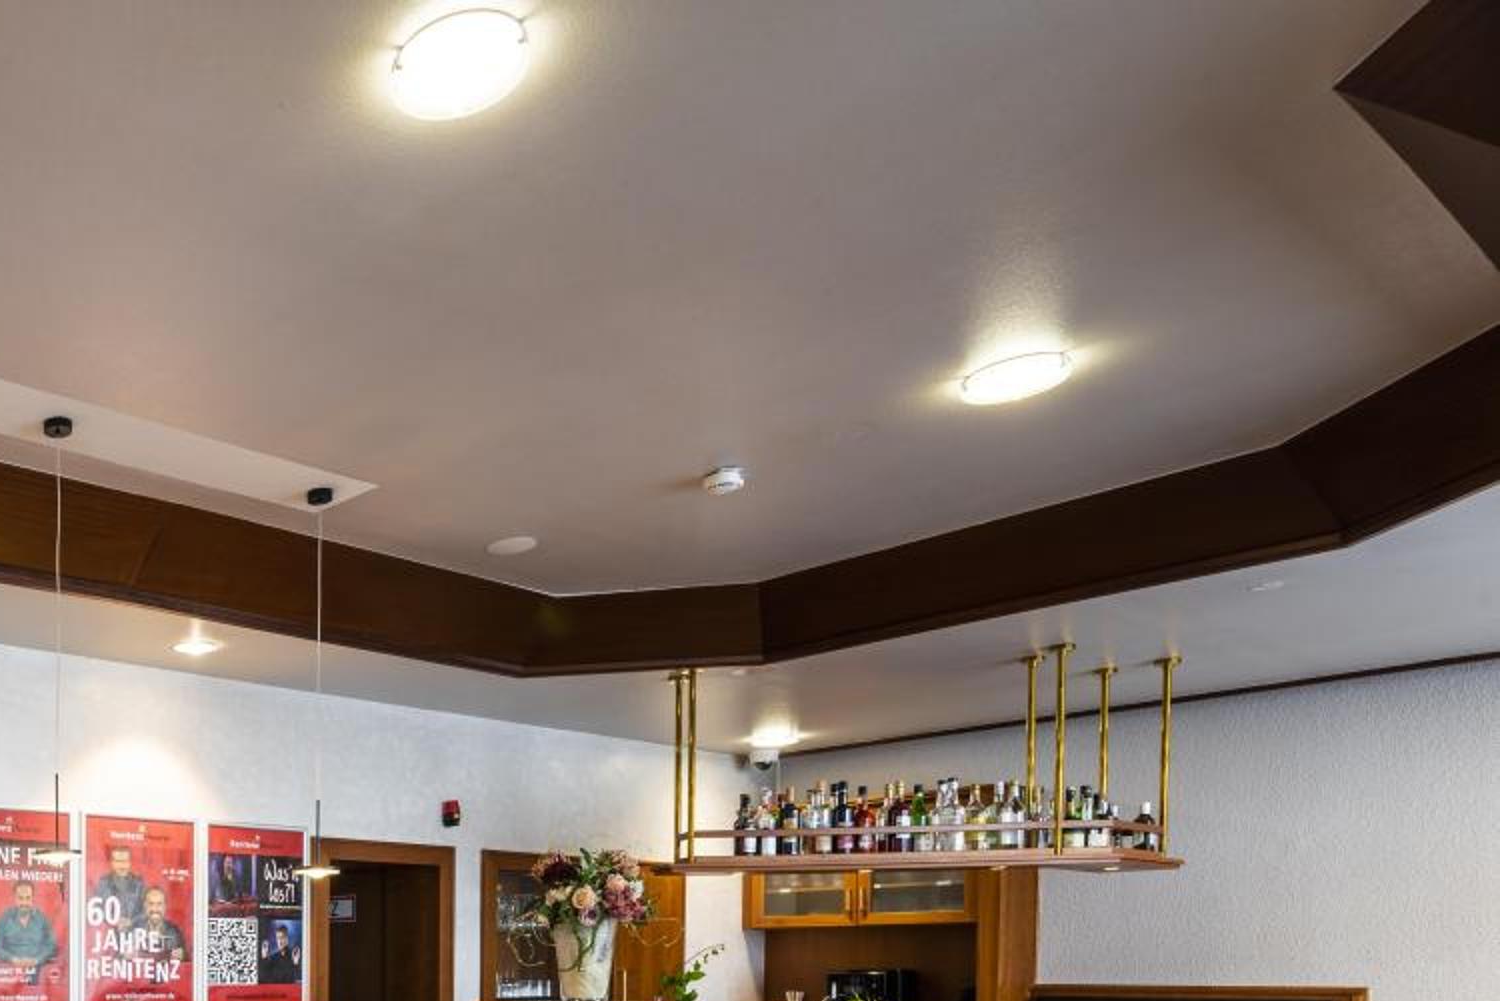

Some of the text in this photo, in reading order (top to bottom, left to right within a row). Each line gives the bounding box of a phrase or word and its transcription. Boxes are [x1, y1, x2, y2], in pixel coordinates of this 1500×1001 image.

[87, 895, 121, 927] 60
[91, 927, 163, 953] JAHRE
[87, 956, 181, 983] RENITENZ
